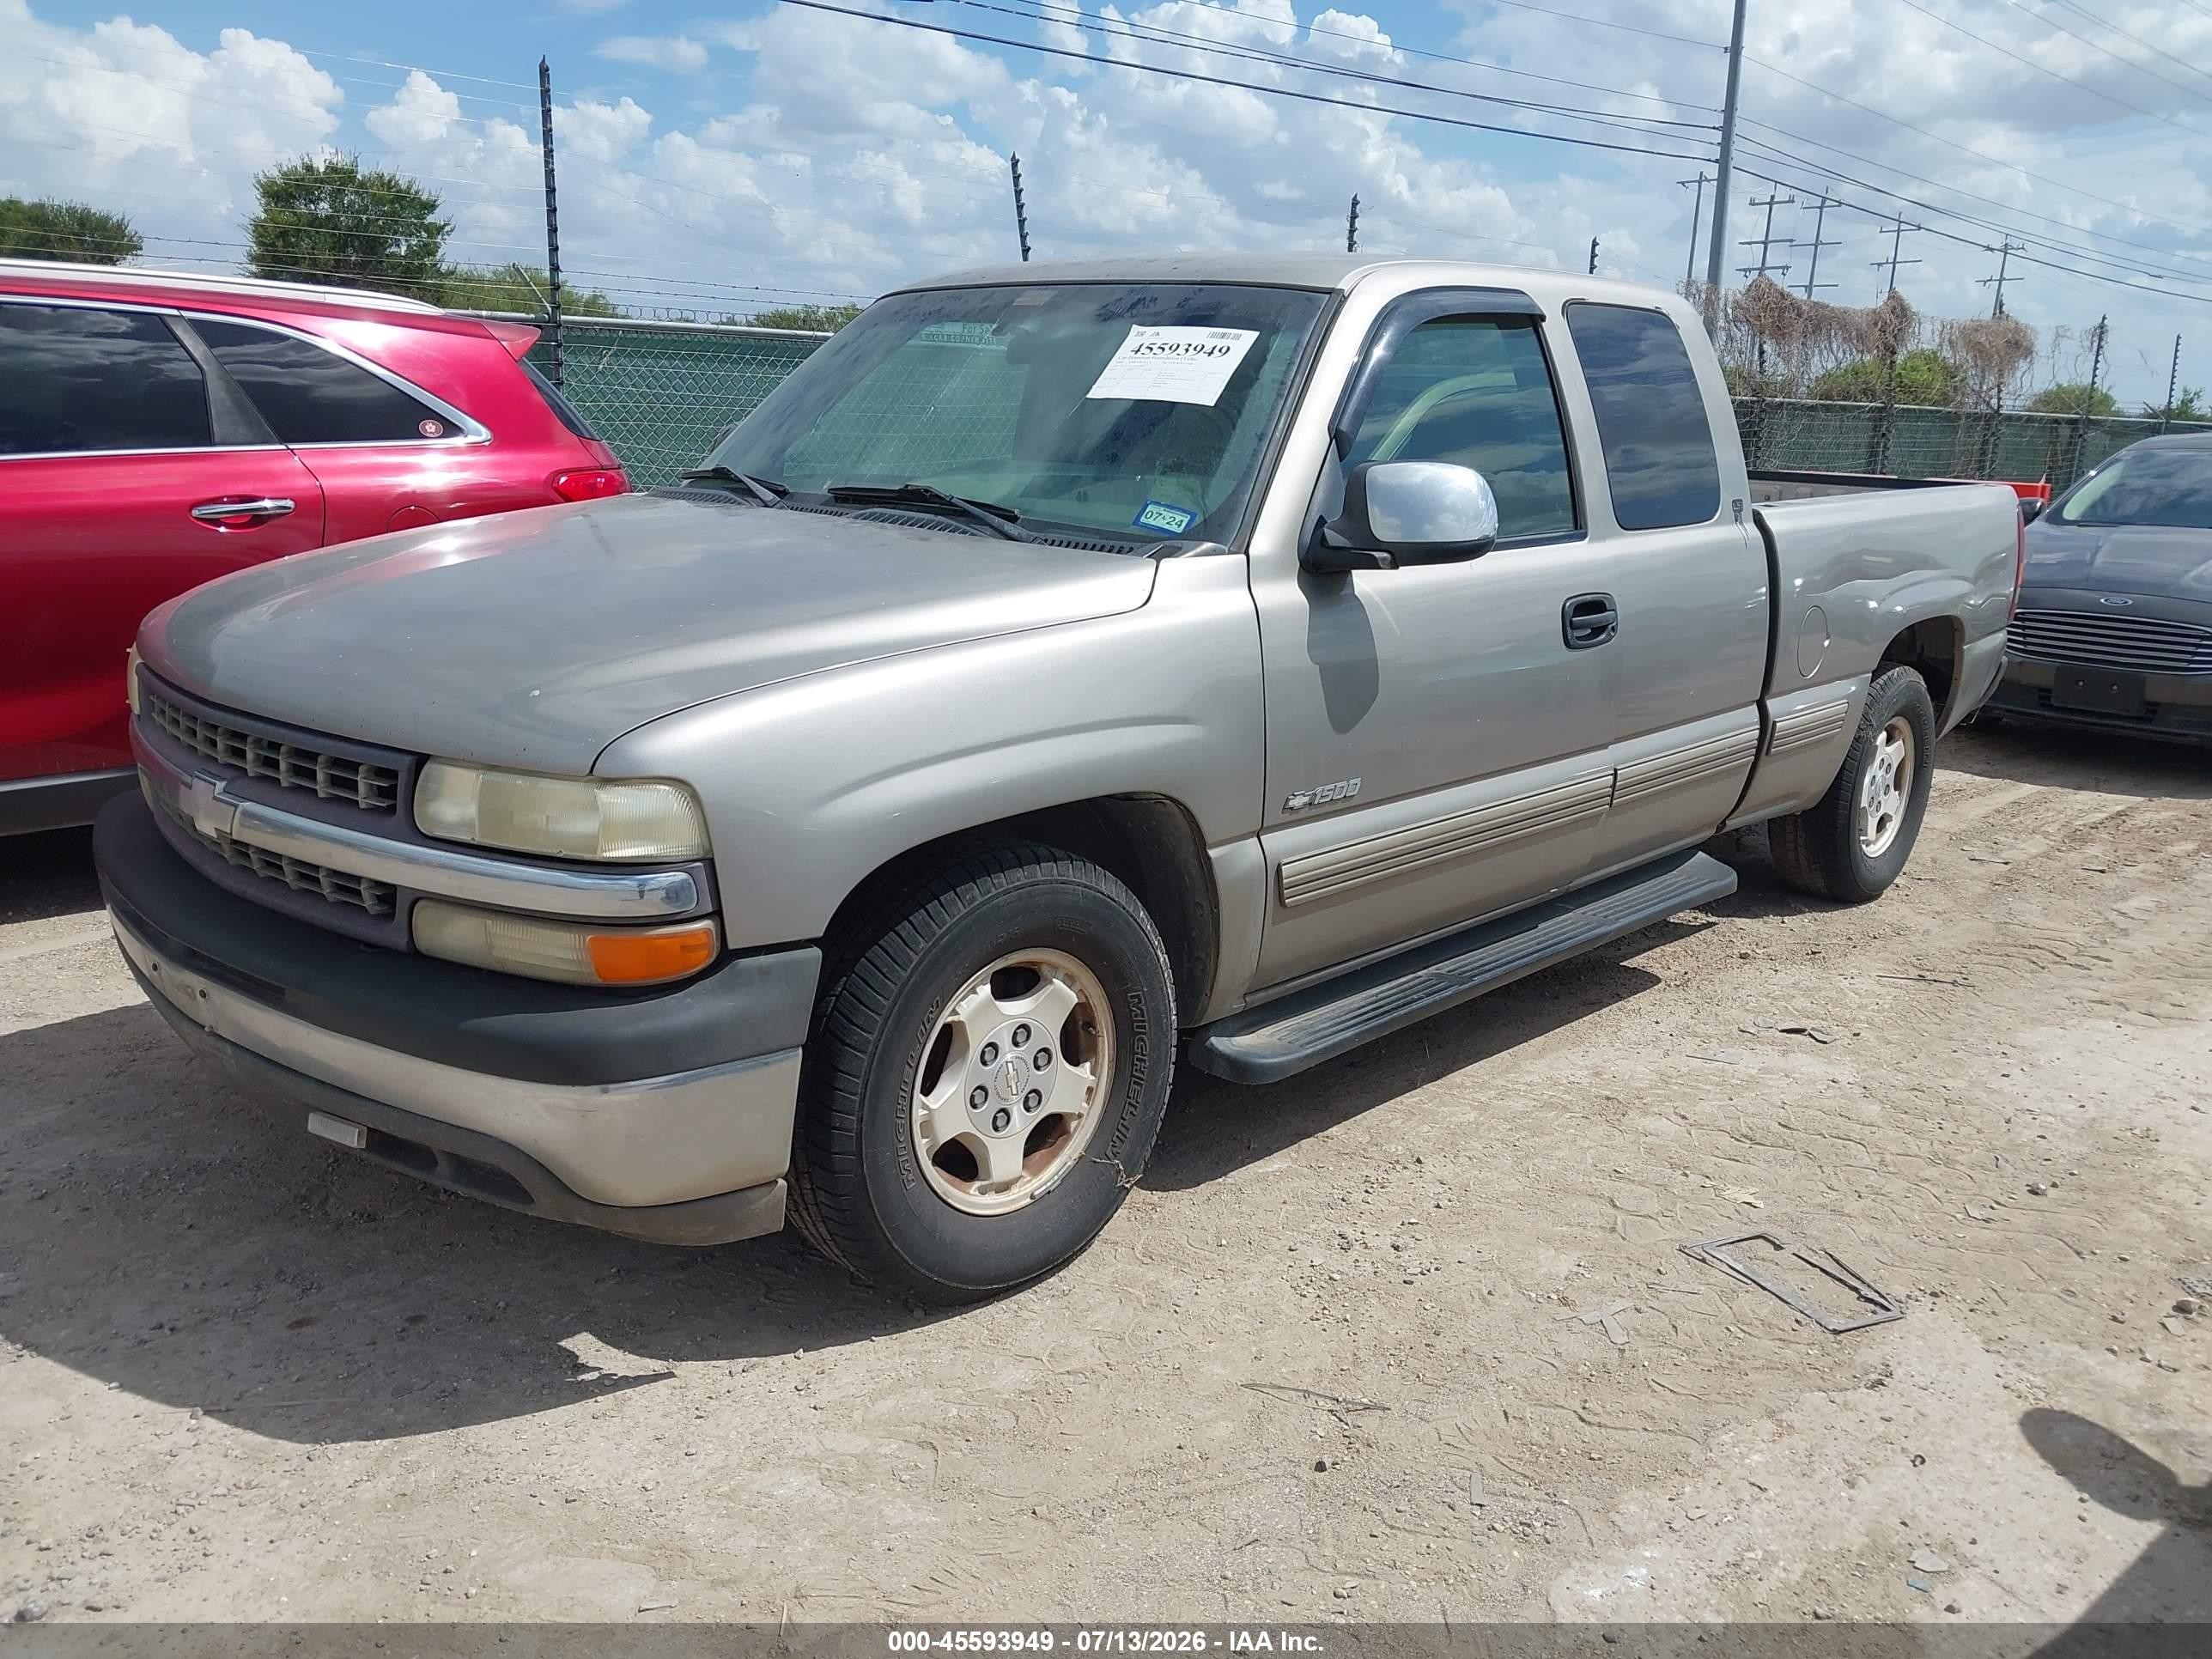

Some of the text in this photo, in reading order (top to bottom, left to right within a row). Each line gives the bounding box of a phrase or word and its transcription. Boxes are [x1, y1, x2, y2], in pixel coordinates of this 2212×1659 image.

[1130, 342, 1231, 359] 45593949
[1314, 778, 1361, 805] 1500
[1104, 990, 1151, 1163] MICHELIN
